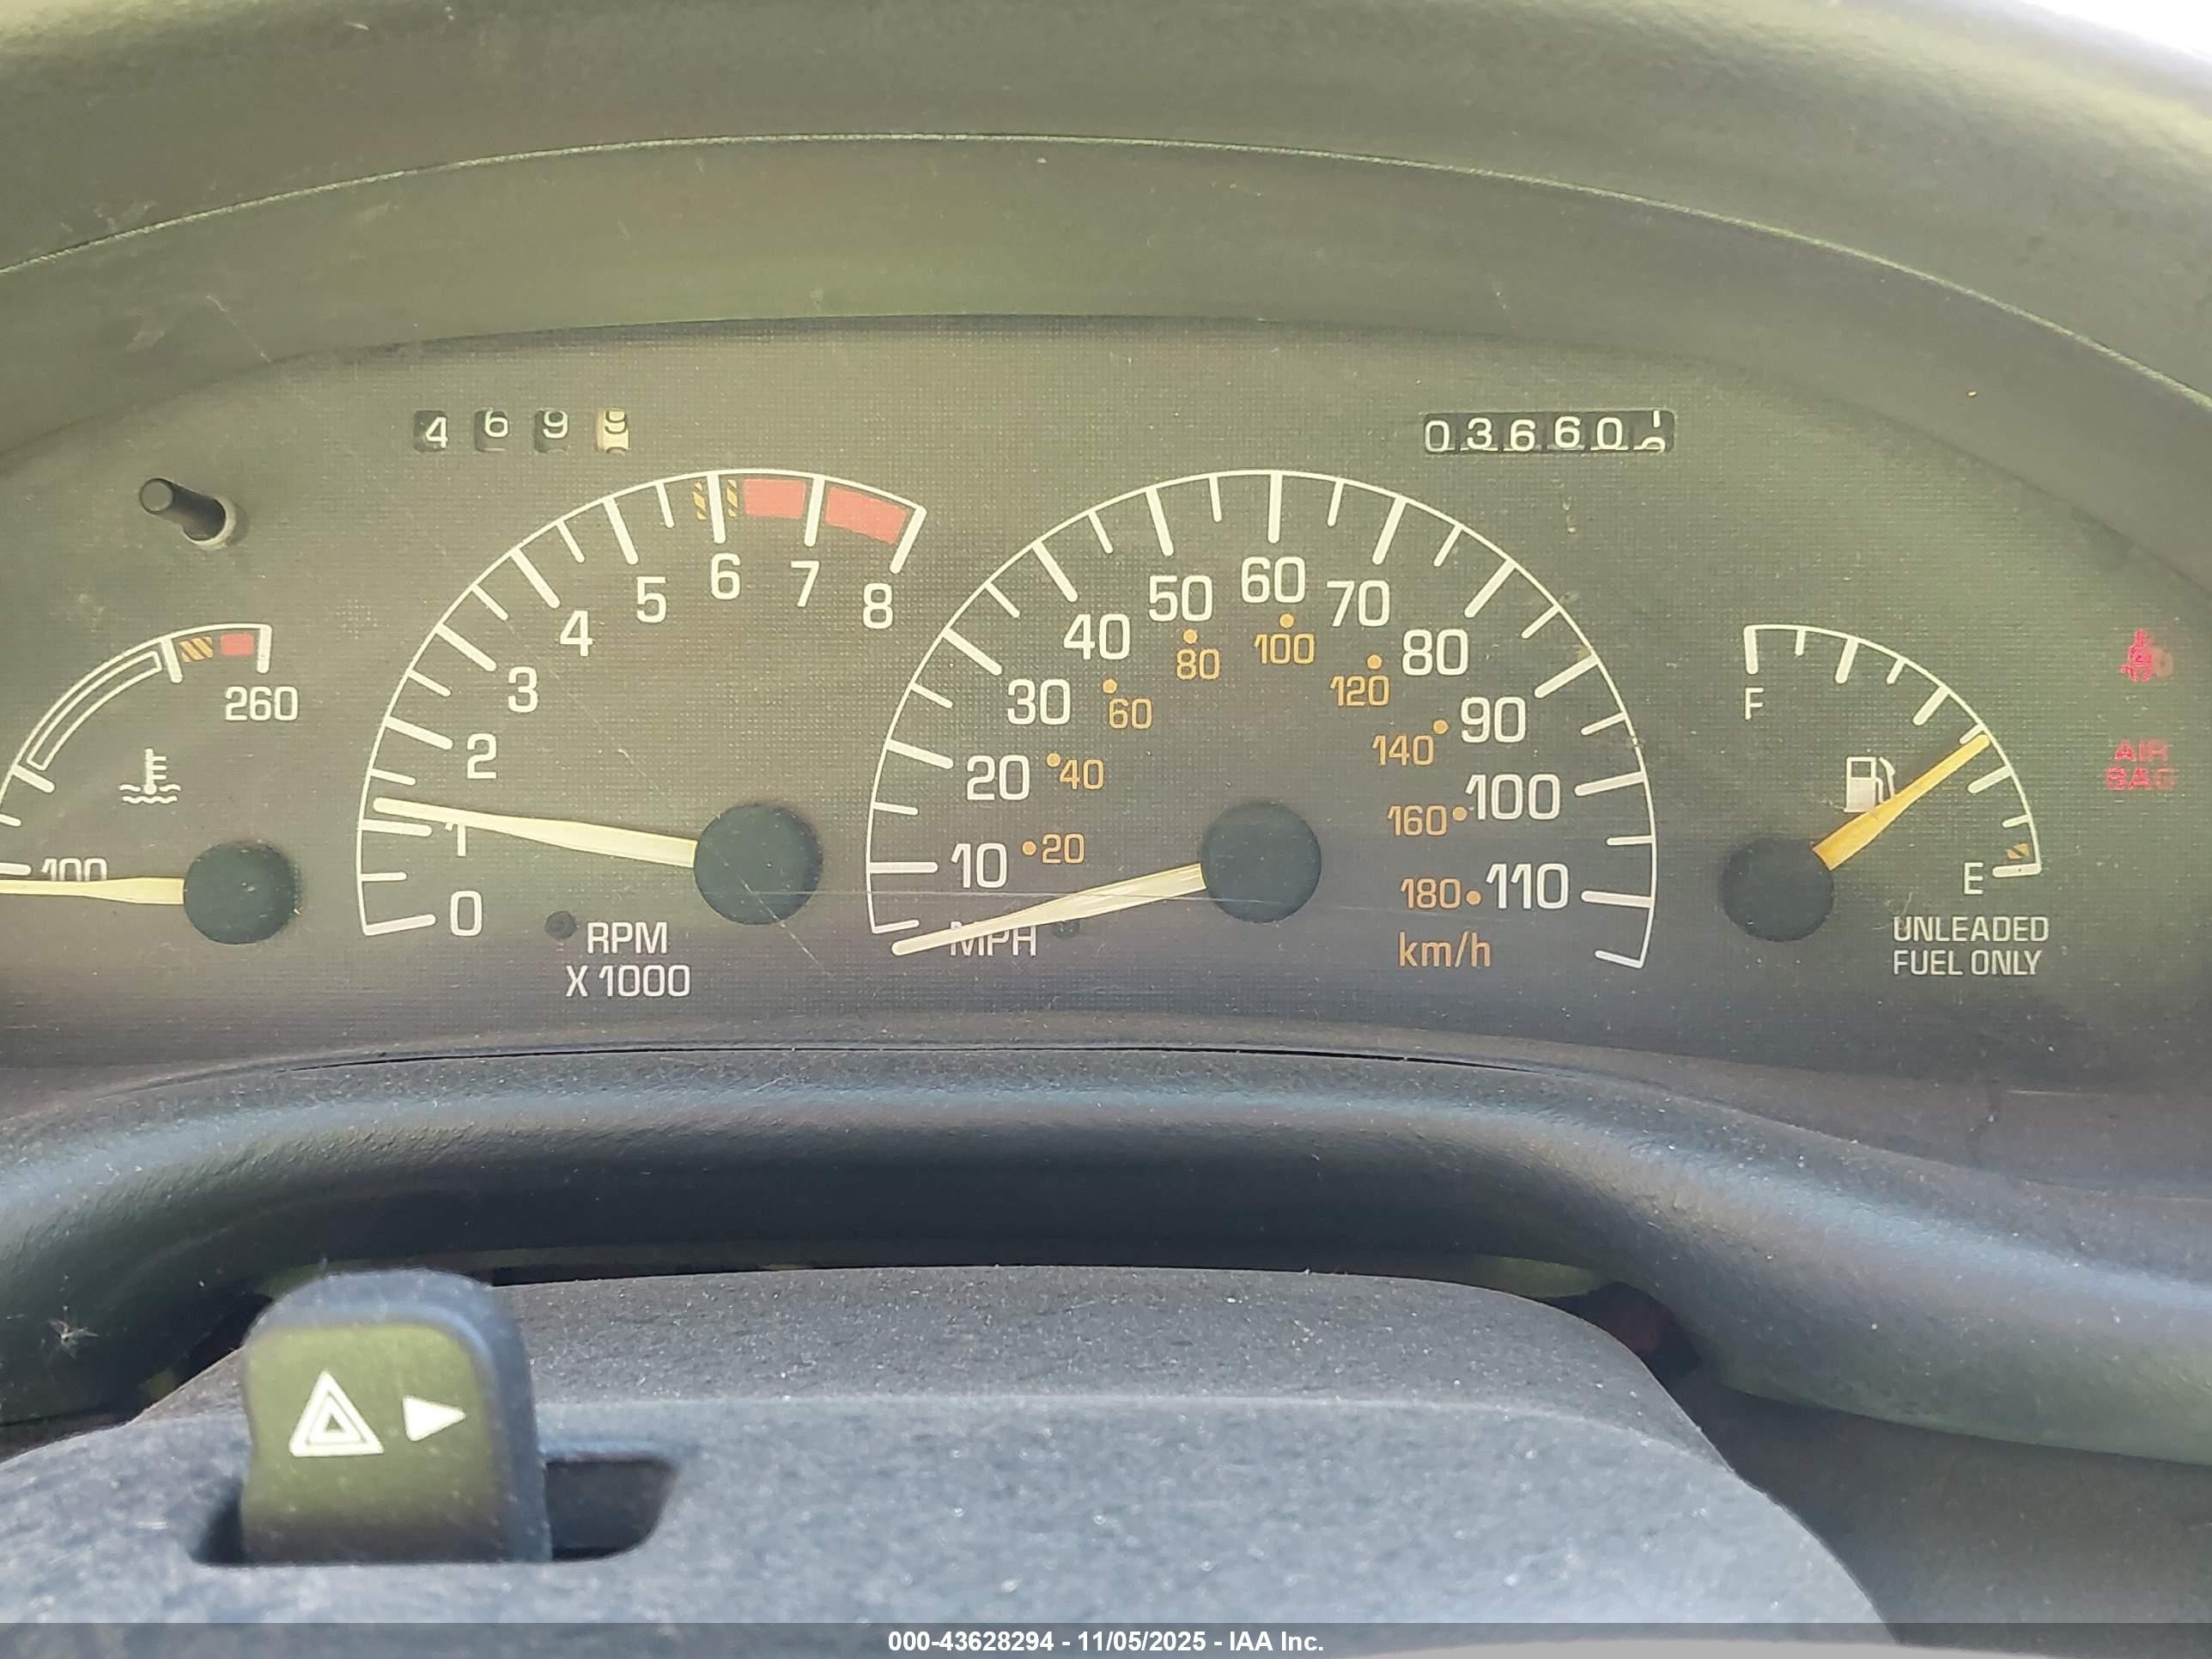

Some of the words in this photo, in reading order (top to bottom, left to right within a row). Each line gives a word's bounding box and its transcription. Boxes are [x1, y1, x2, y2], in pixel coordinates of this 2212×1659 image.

[425, 416, 448, 448] 4
[483, 410, 509, 438] 6
[542, 410, 568, 439] 9
[710, 552, 741, 600] 6
[790, 560, 819, 608] 7
[1241, 556, 1306, 604] 60
[635, 575, 667, 623] 5
[862, 582, 893, 629] 8
[1148, 574, 1213, 622] 50
[1326, 580, 1390, 627] 70
[559, 609, 592, 657] 4
[1063, 612, 1131, 660] 40
[1254, 633, 1315, 665] 100
[1176, 648, 1221, 680] 80
[1401, 628, 1469, 676] 80
[224, 686, 299, 721] 260
[507, 665, 538, 713] 3
[1006, 678, 1072, 726] 30
[1330, 675, 1390, 707] 120
[1744, 687, 1765, 720] F
[1109, 698, 1152, 729] 60
[1461, 696, 1527, 744] 90
[465, 732, 497, 780] 2
[1372, 734, 1434, 766] 140
[2114, 738, 2168, 762] AIR
[965, 755, 1030, 801] 20
[1060, 759, 1104, 790] 40
[2106, 766, 2175, 791] BAG
[1465, 774, 1561, 821] 100
[1388, 805, 1448, 836] 160
[951, 842, 1008, 888] 10
[1042, 834, 1085, 864] 20
[1401, 878, 1462, 908] 180
[1486, 863, 1570, 909] 110
[1963, 862, 1984, 895] E
[450, 890, 483, 936] 0
[1893, 916, 2050, 943] UNLEADED
[586, 921, 668, 953] RPM
[950, 921, 1037, 957] MPH
[1397, 932, 1492, 969] km/h
[564, 964, 589, 997] X
[598, 963, 691, 997] 1000
[1893, 950, 1964, 975] FUEL
[1971, 950, 2043, 975] ONLY
